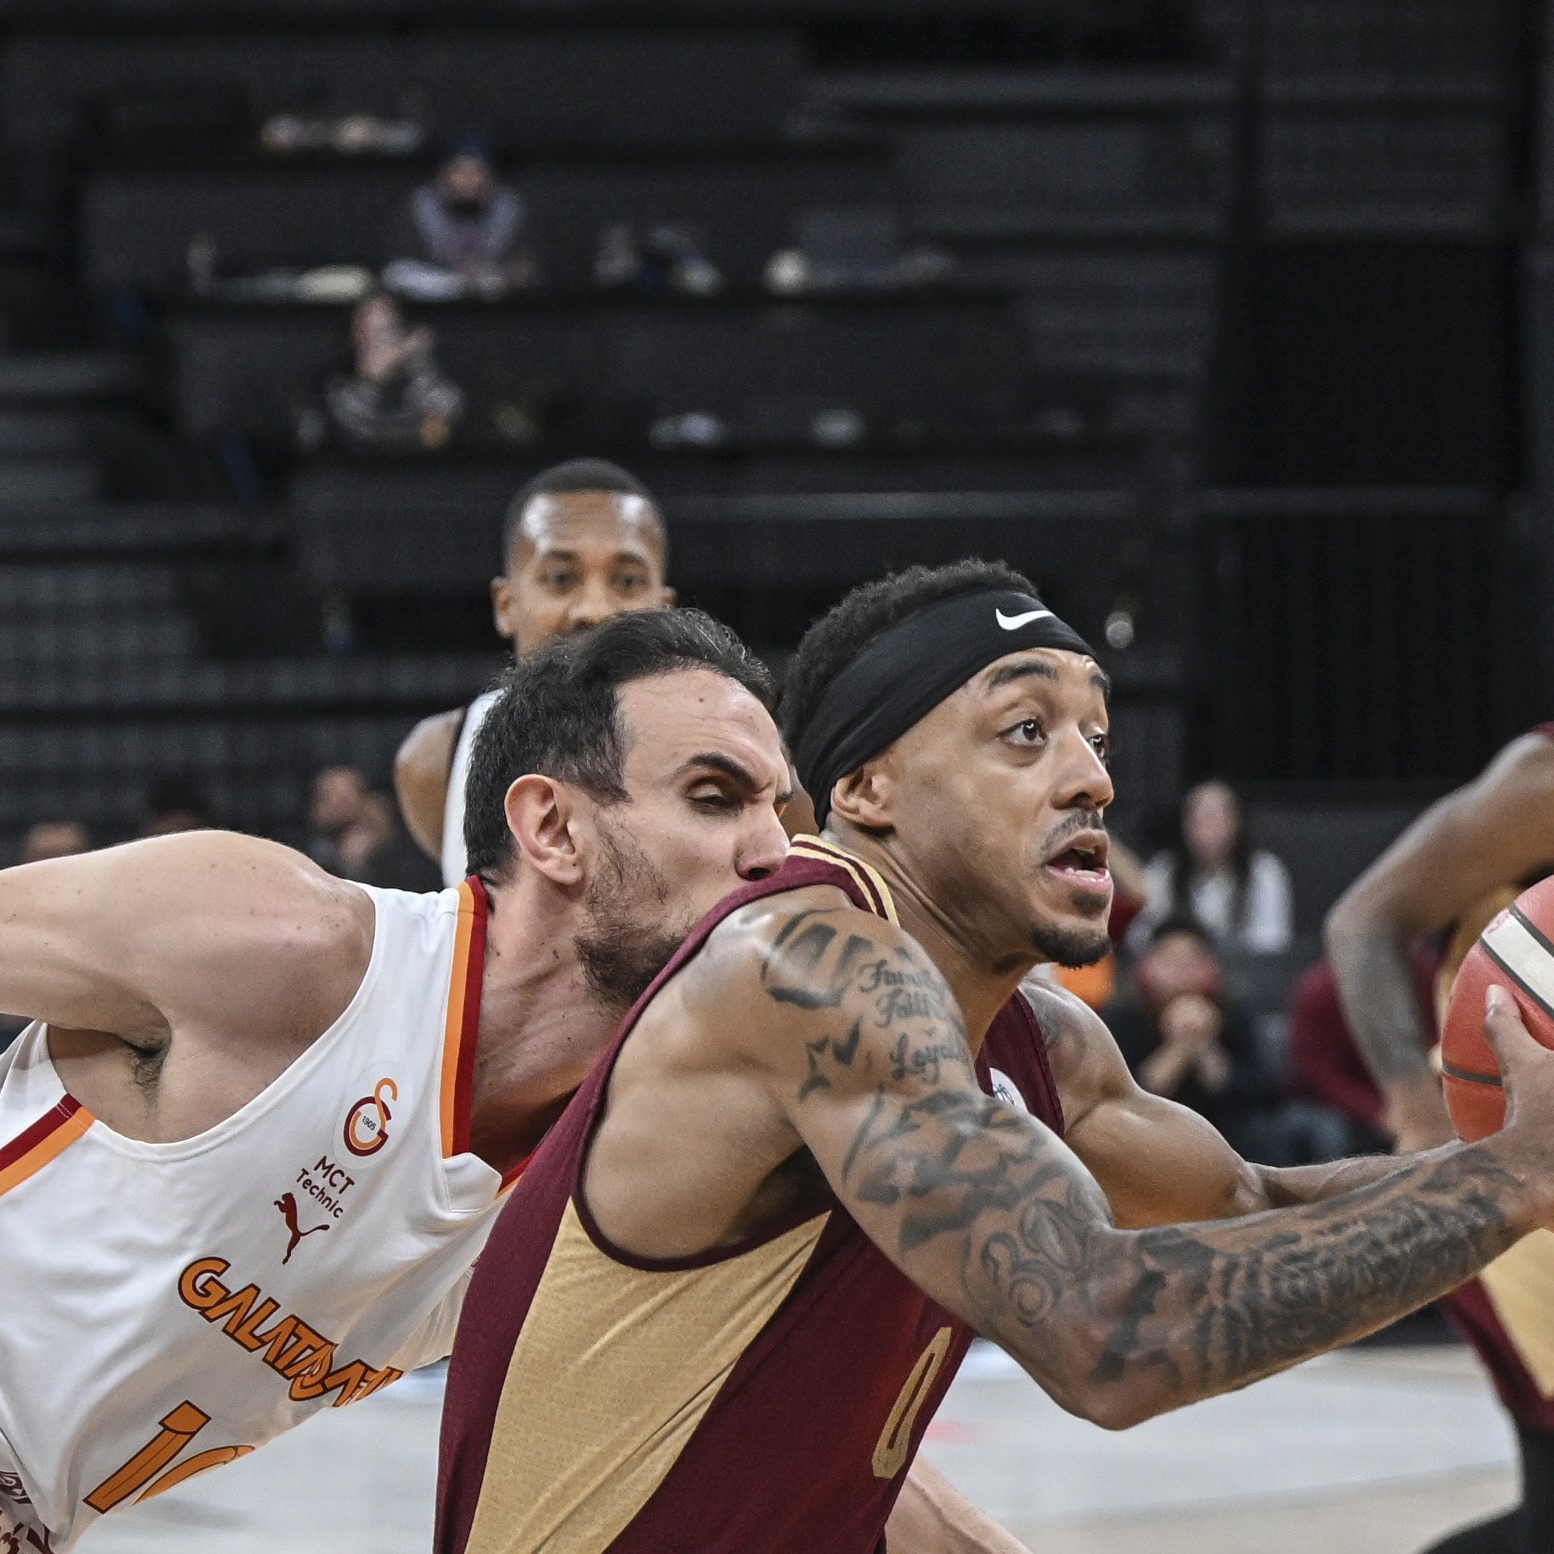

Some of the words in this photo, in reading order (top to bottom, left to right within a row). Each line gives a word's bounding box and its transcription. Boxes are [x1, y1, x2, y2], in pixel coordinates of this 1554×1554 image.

[361, 1115, 376, 1131] 1905
[296, 1168, 344, 1219] Technic
[313, 1155, 355, 1195] MCT
